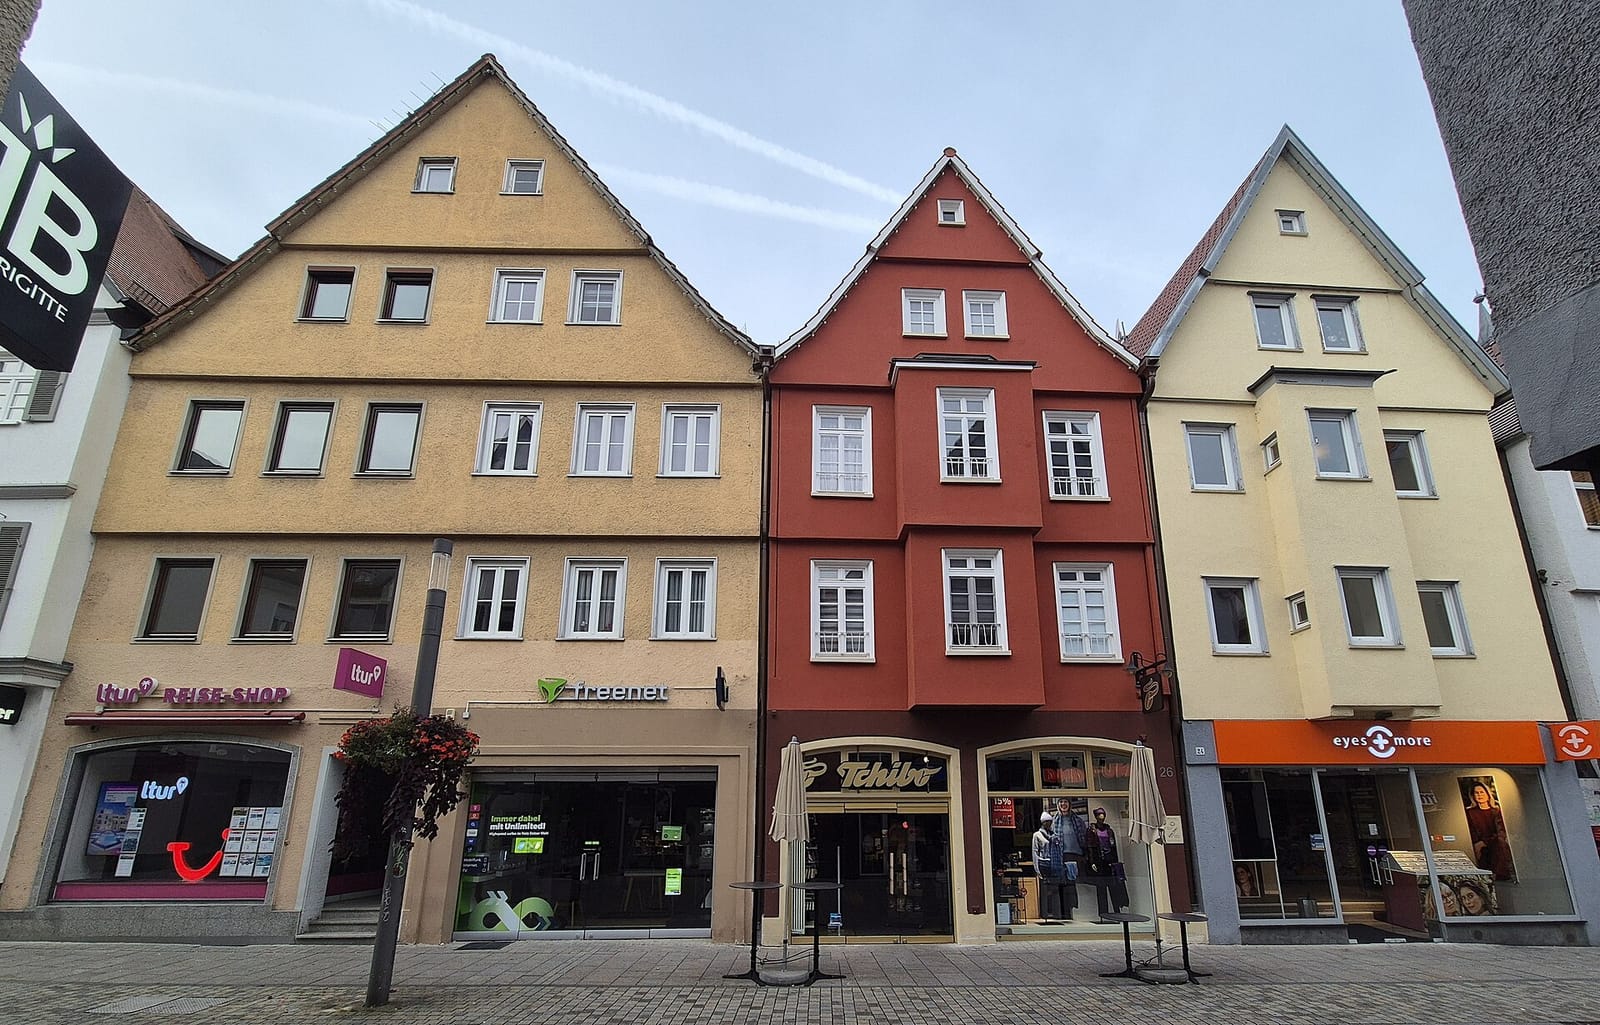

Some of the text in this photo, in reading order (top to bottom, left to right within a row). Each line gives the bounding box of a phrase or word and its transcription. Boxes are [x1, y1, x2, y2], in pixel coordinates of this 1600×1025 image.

[163, 686, 291, 705] REISE-SHOP
[574, 680, 669, 701] freenet
[1332, 736, 1432, 749] eyes more
[836, 760, 943, 788] Tchibo
[1159, 766, 1175, 778] 26
[994, 797, 1012, 806] 15%
[489, 822, 504, 830] mit
